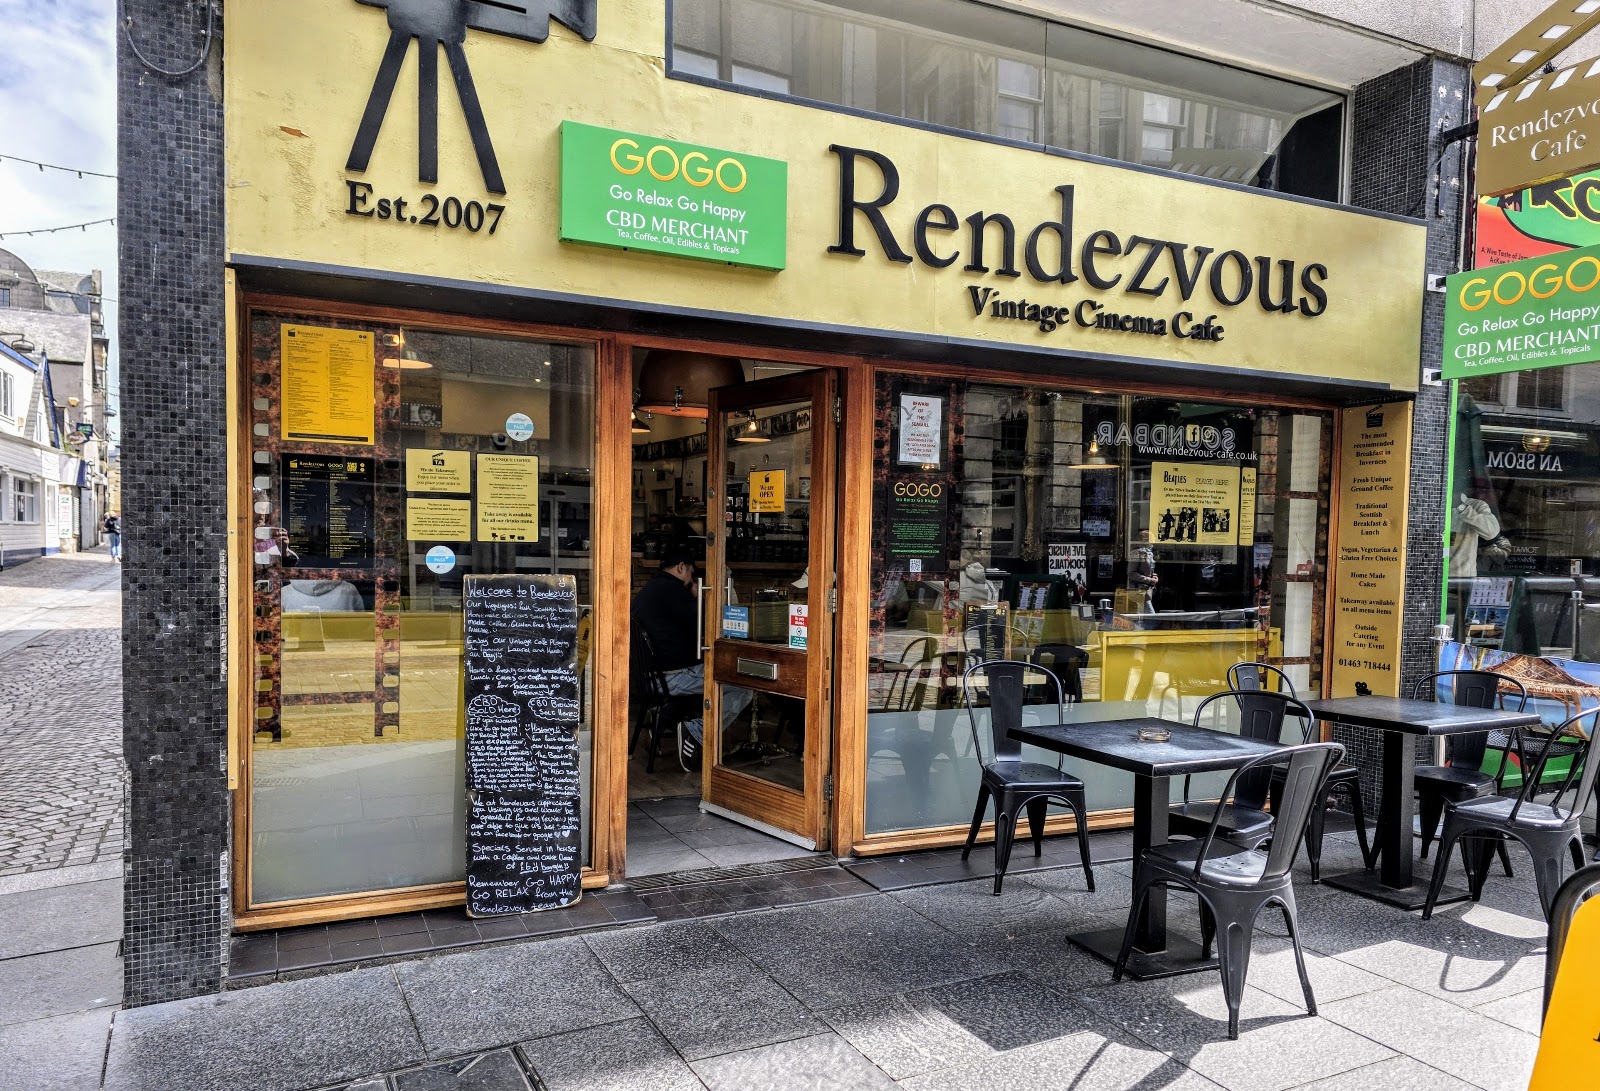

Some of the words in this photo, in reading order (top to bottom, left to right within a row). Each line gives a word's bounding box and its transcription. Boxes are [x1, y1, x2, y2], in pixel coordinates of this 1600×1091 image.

[1530, 129, 1587, 161] Cafe
[610, 138, 747, 193] GOGO
[346, 180, 505, 234] Est.2007
[609, 184, 632, 201] Go
[637, 189, 673, 208] Relax
[678, 196, 698, 211] Go
[703, 200, 746, 222] Happy
[606, 209, 646, 229] CBD
[651, 216, 749, 245] MERCHANT
[827, 144, 1328, 317] Rendezvous
[616, 228, 632, 239] Tea,
[634, 231, 660, 243] Coffee,
[662, 236, 675, 246] Oil,
[678, 238, 702, 249] Edibles
[704, 242, 710, 250] &
[713, 243, 739, 254] Topicals
[1498, 250, 1511, 258] Taste
[1459, 256, 1600, 312] GOGO
[968, 285, 1069, 333] Vintage
[1075, 299, 1168, 335] Cinema
[1172, 311, 1225, 342] Cafe
[1458, 323, 1478, 336] Go
[1482, 316, 1518, 332] Relax
[1523, 312, 1545, 326] Go
[1550, 306, 1600, 323] Happy
[1454, 341, 1491, 358] CBD
[1496, 324, 1600, 354] MERCHANT
[1479, 357, 1504, 366] Coffee,
[1507, 354, 1519, 362] Oil,
[1522, 350, 1548, 360] Edibles
[1560, 344, 1591, 355] Topicals
[1353, 440, 1394, 449] recommended
[1138, 445, 1258, 461] www.rendezvous-cafe.co.uk
[1356, 450, 1384, 458] Breakfast
[894, 482, 942, 497] GOGO
[1360, 546, 1391, 554] Vegetarian
[1358, 580, 1376, 588] Cakes
[516, 585, 527, 596] to
[1340, 597, 1368, 606] Takeaway
[1369, 599, 1395, 607] available
[1376, 607, 1392, 615] items
[1355, 624, 1377, 632] Outside
[1353, 632, 1378, 641] Catering
[1368, 642, 1385, 650] Event
[1338, 658, 1361, 668] 01463
[1364, 661, 1391, 671] 718444
[474, 698, 497, 707] CBD
[530, 699, 548, 707] CBD
[498, 704, 517, 713] Here
[470, 794, 484, 807] We
[472, 807, 485, 818] you
[472, 843, 511, 854] Specials
[546, 844, 553, 852] in
[556, 844, 577, 852] house
[468, 875, 519, 888] Remember
[549, 873, 579, 885] HAPPY
[495, 887, 529, 898] RELAX
[535, 887, 558, 898] from
[559, 888, 574, 896] the
[531, 902, 558, 910] team
